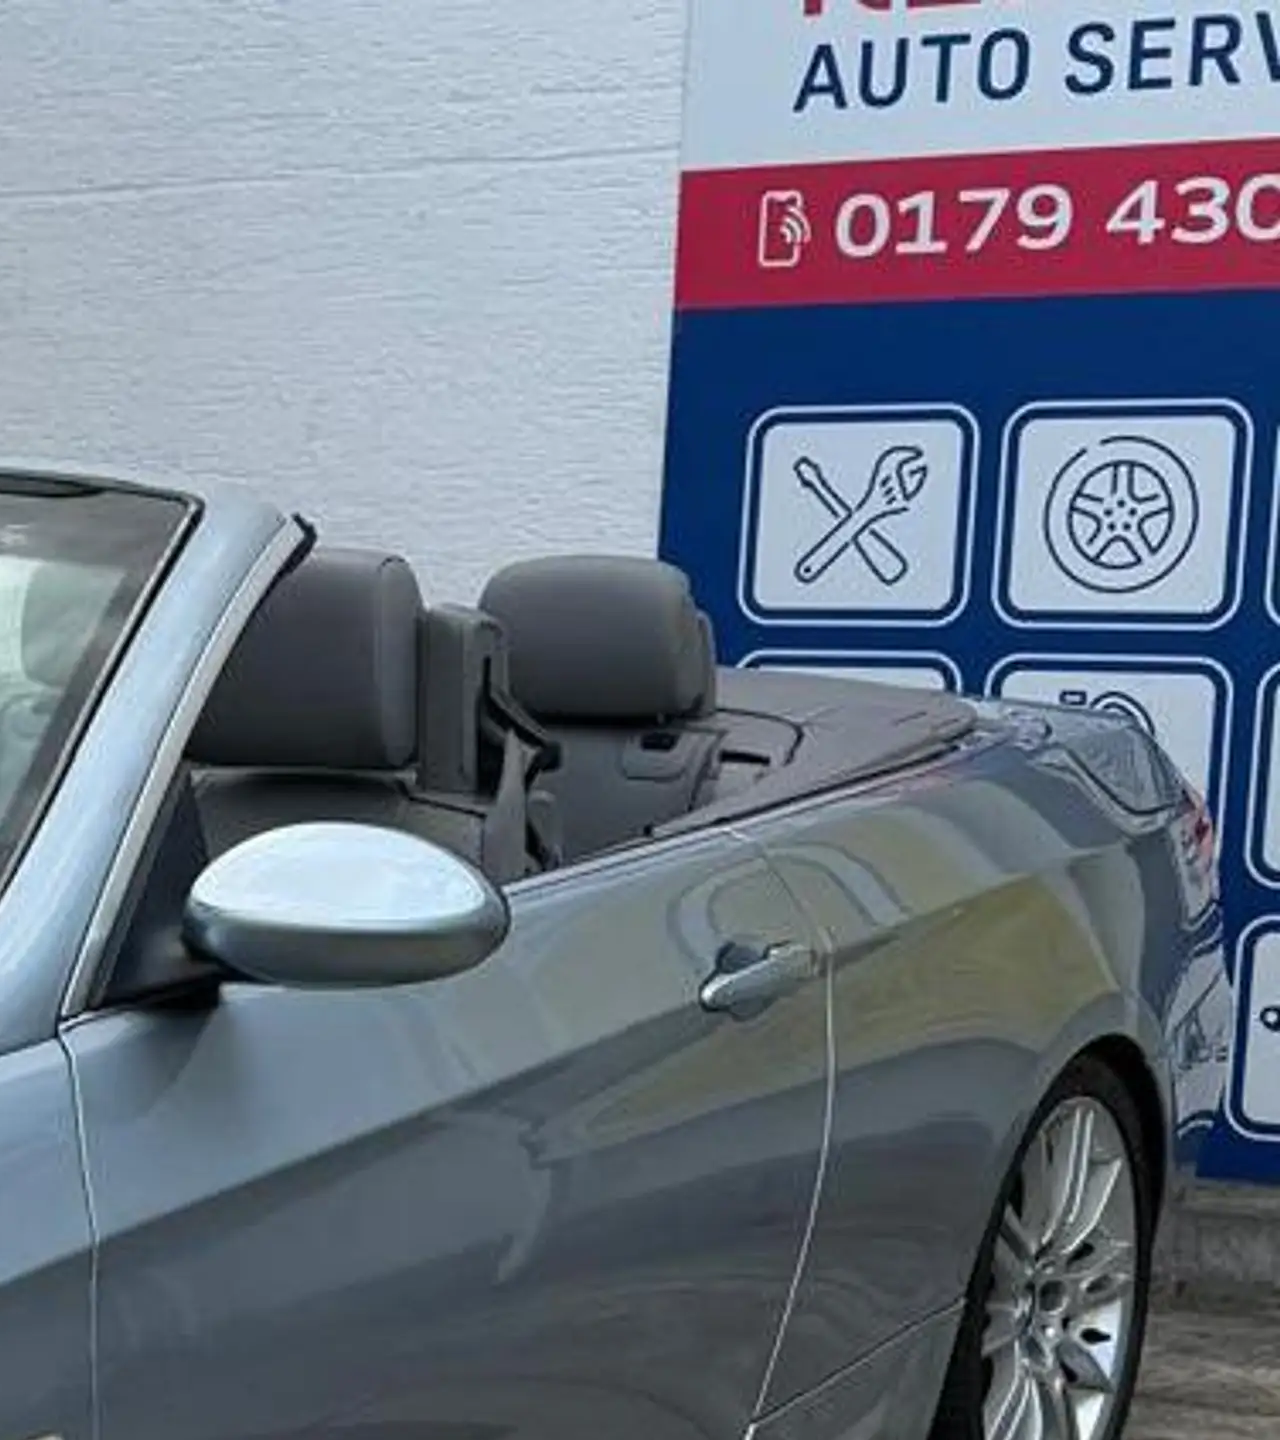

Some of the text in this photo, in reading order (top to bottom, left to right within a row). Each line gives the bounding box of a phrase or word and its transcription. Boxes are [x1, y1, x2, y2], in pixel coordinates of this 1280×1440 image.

[793, 28, 1032, 113] AUTO
[835, 173, 1280, 258] 0179 430
